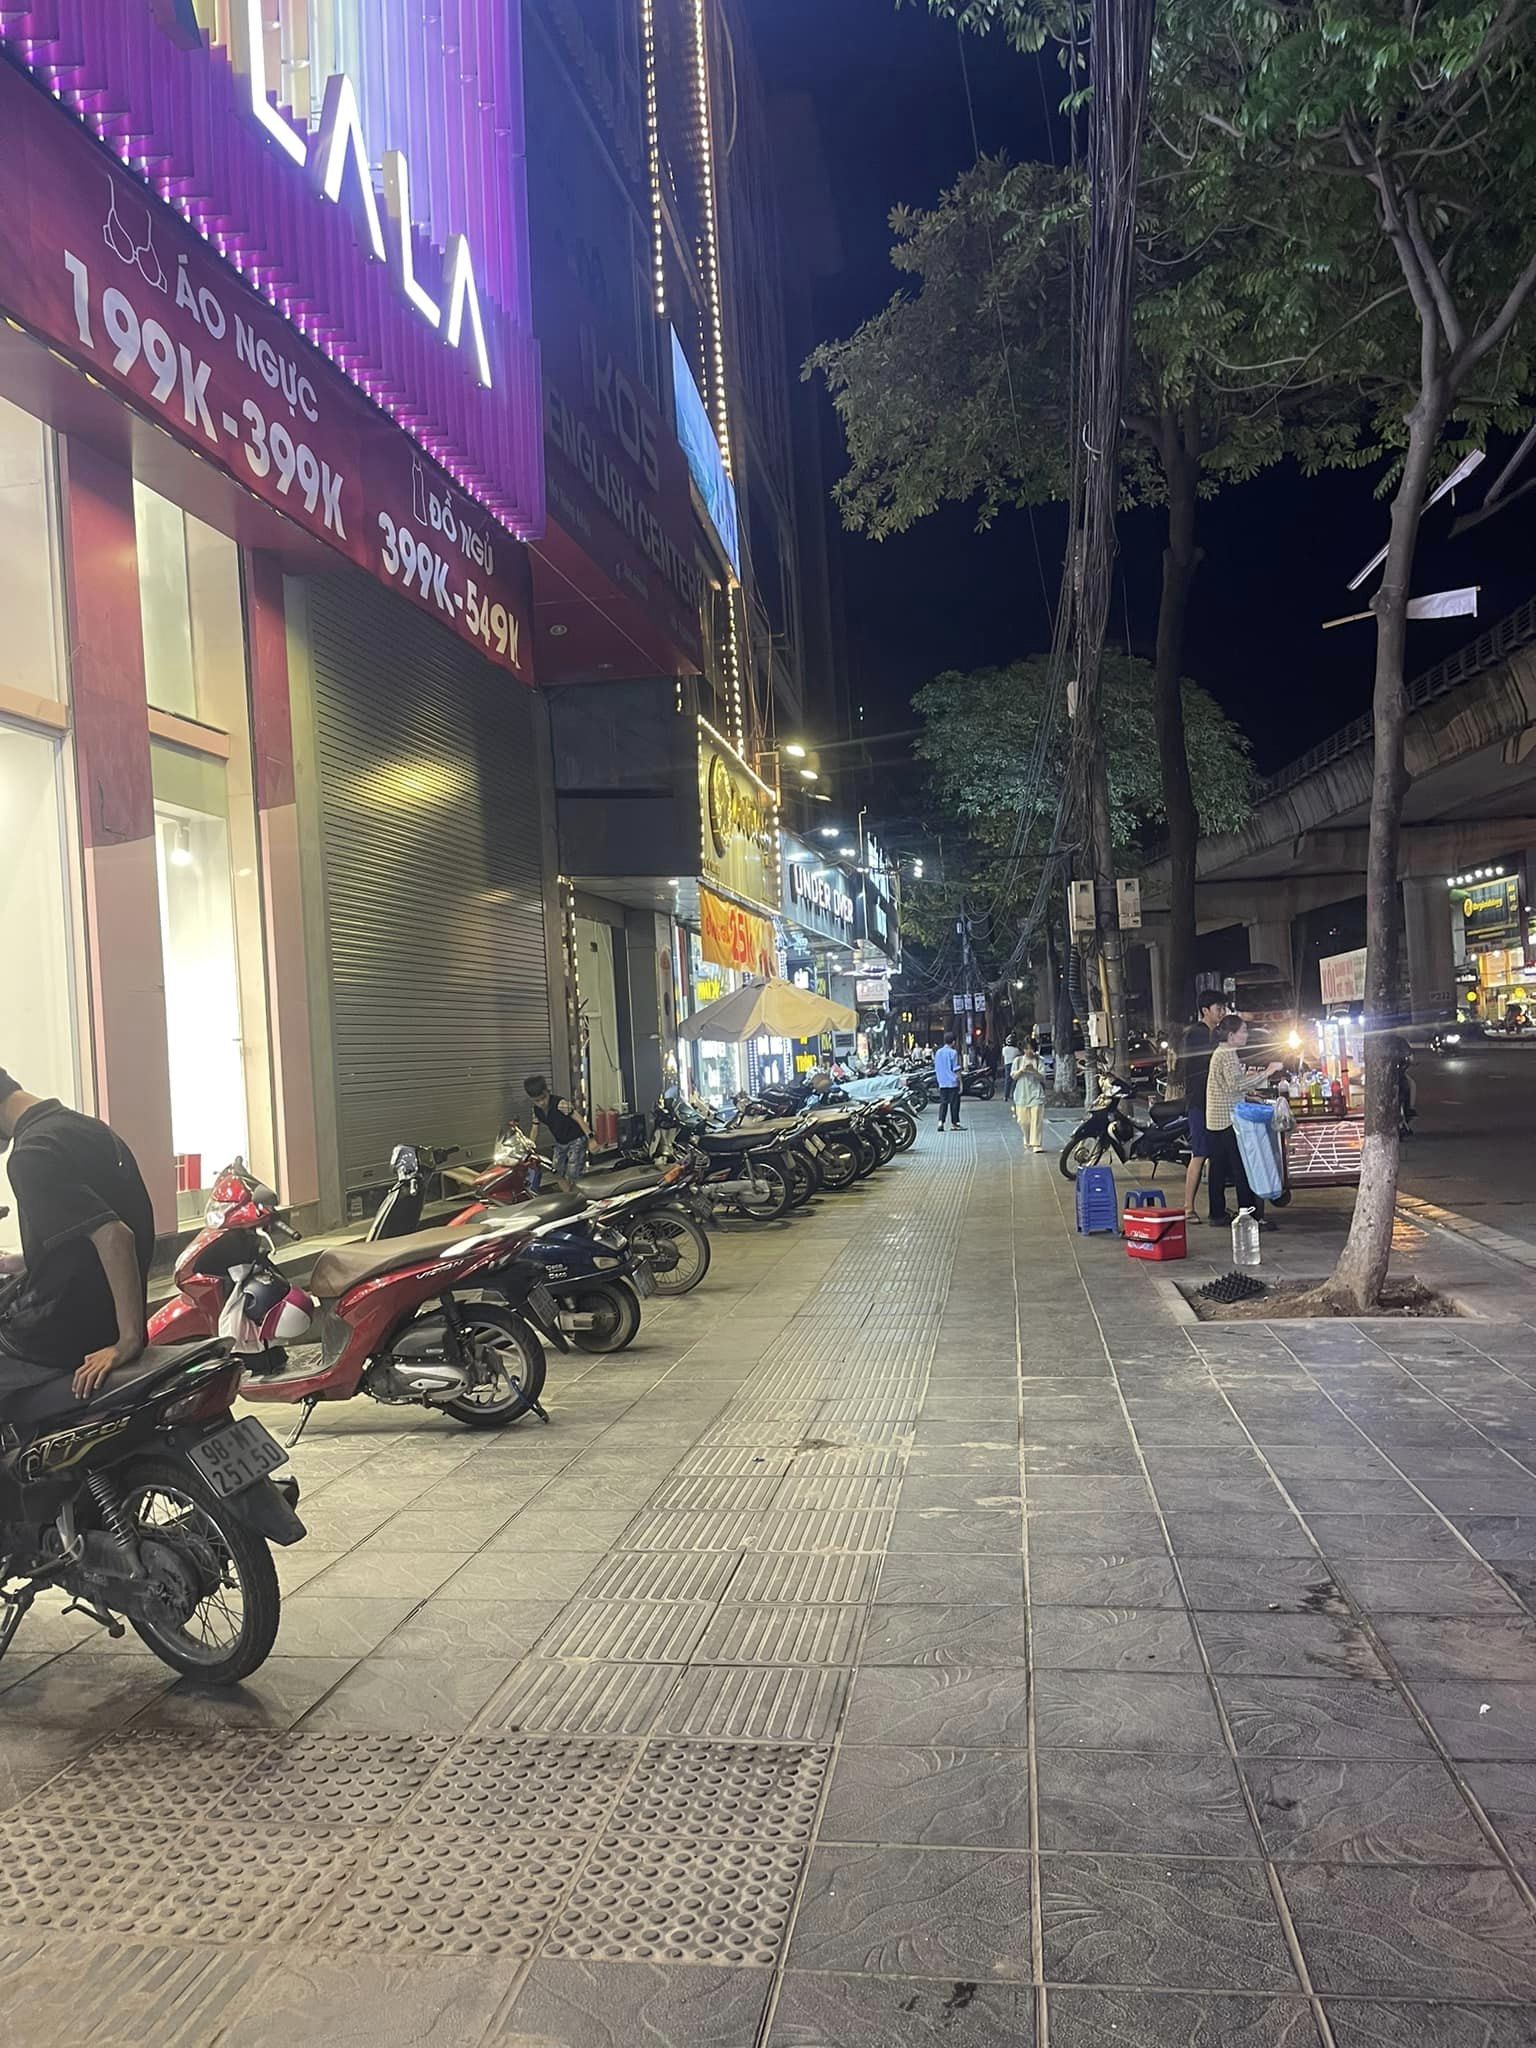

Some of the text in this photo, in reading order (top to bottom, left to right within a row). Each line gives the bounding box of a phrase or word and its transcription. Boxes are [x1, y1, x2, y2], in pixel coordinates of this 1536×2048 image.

[234, 313, 319, 423] NGỰC
[428, 491, 459, 544] ĐỒ
[548, 381, 636, 537] ENGLISH
[637, 500, 699, 609] CENTER
[794, 863, 832, 911] UNDER
[212, 1441, 281, 1493] 251.50
